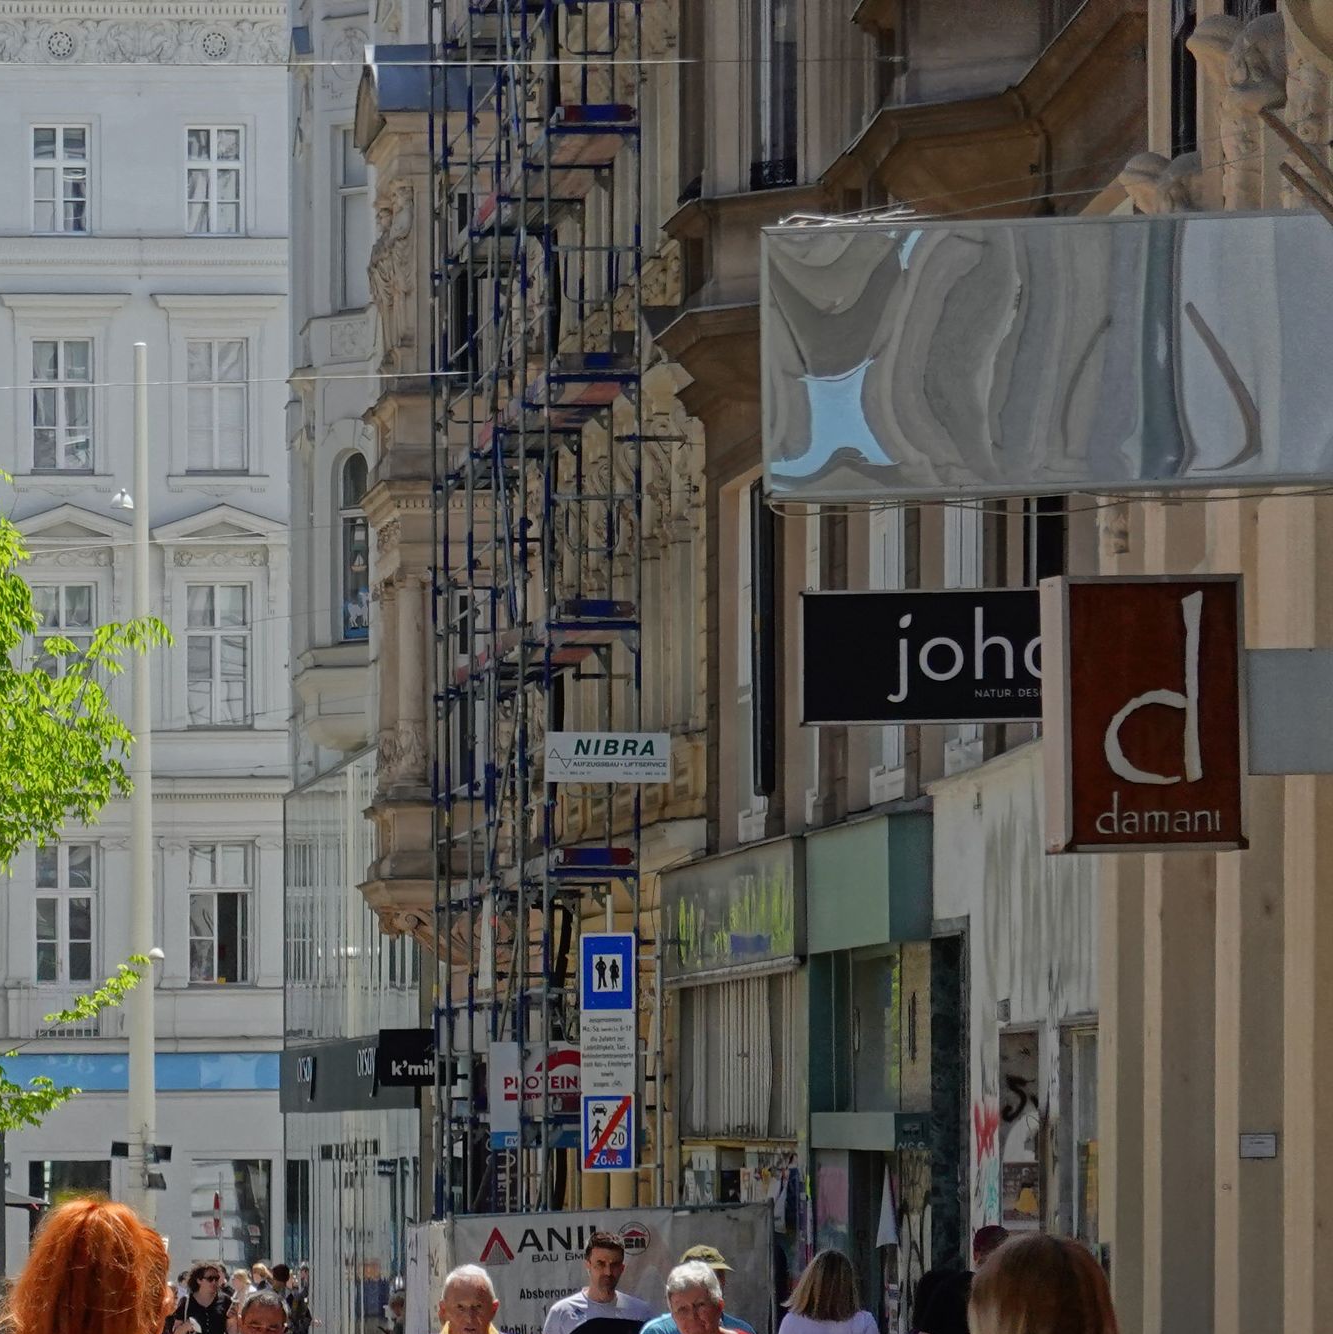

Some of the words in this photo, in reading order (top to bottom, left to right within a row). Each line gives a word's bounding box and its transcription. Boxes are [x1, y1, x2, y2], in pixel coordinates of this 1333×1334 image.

[1104, 591, 1203, 785] d
[574, 739, 655, 756] NIBRA
[1095, 791, 1221, 834] damani
[503, 1076, 578, 1090] POEIN
[611, 1131, 625, 1146] 20
[593, 1153, 623, 1165] Zone
[531, 1253, 559, 1264] BAU
[564, 1251, 587, 1262] GM
